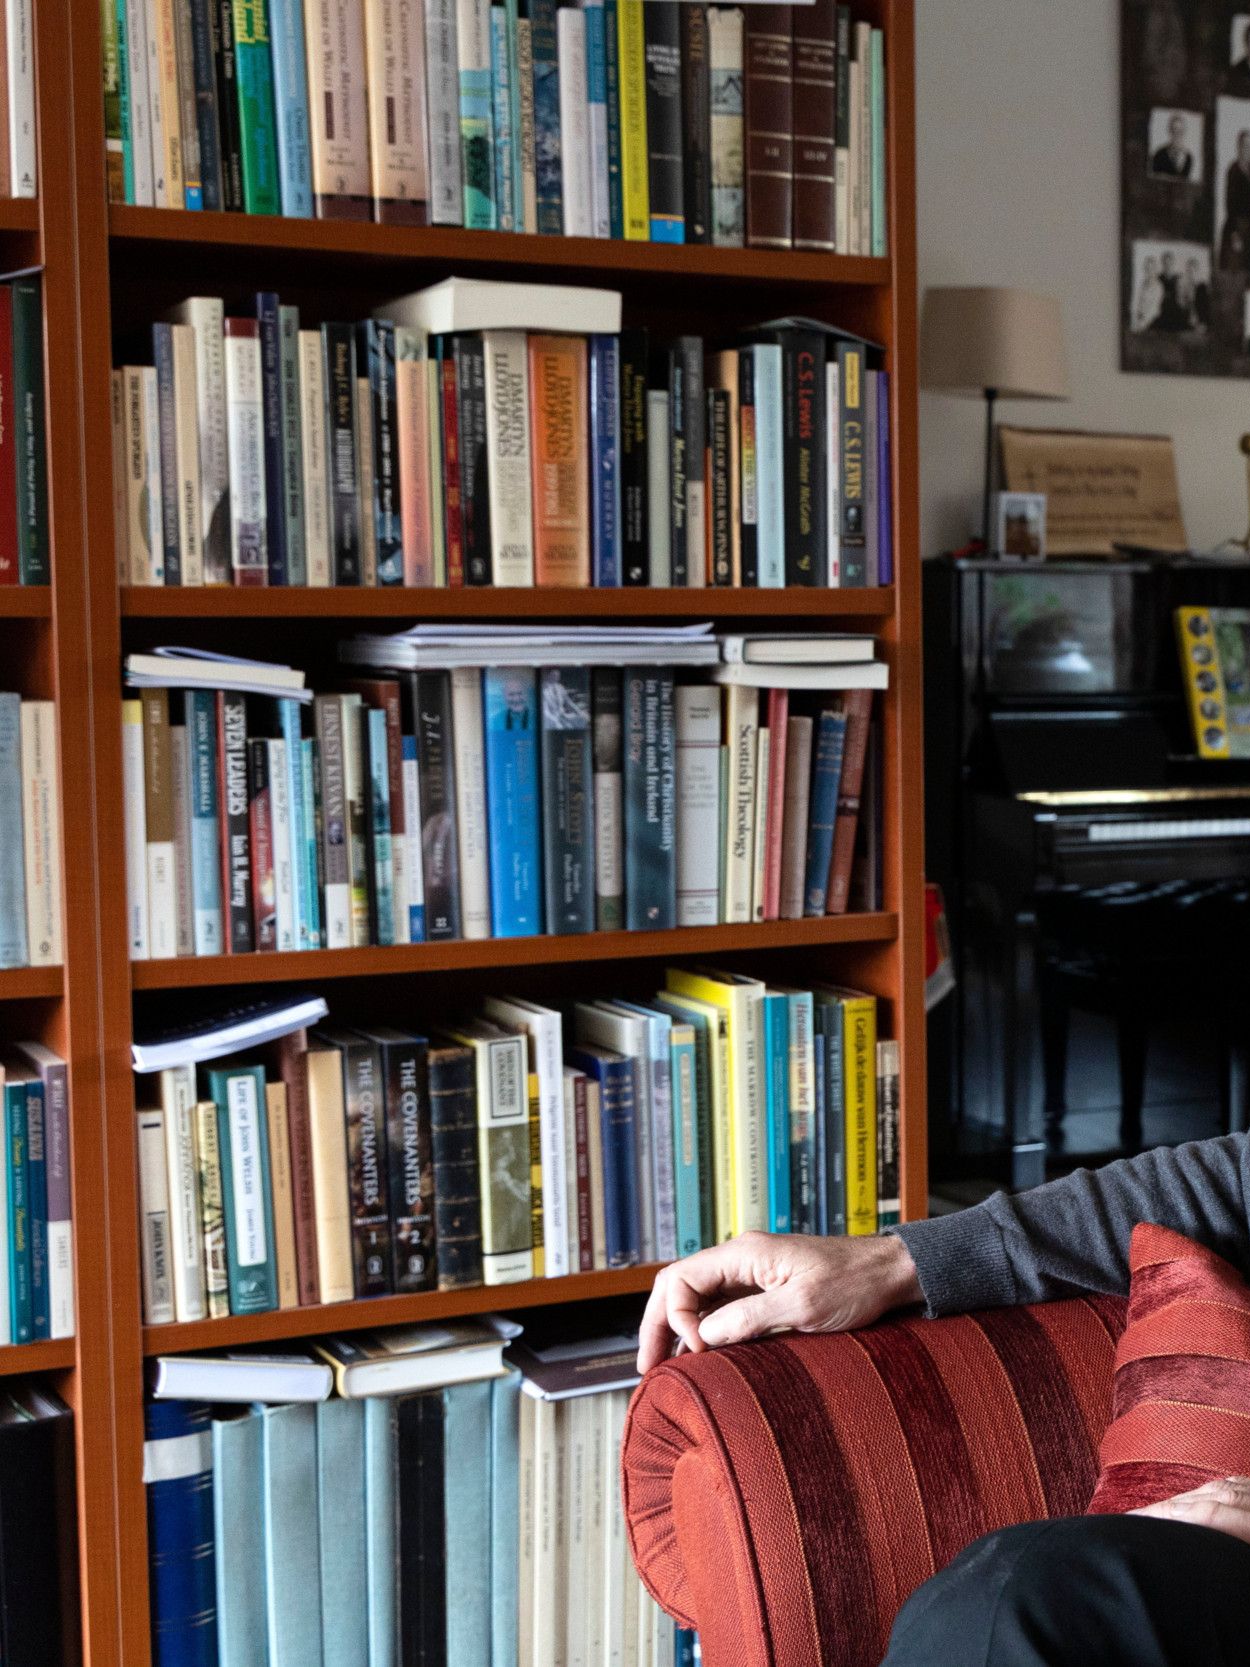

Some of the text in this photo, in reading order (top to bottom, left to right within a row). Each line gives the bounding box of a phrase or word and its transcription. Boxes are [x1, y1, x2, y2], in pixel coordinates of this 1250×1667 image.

[225, 52, 233, 78] Evans
[461, 354, 471, 389] Murray
[24, 392, 34, 417] Liberty
[799, 389, 815, 439] Lewis
[25, 418, 33, 433] and
[336, 428, 354, 494] AUTOBIOGRAPHY
[674, 439, 685, 471] Martyn
[845, 453, 861, 499] LEWIS
[27, 492, 36, 515] Pursuit
[28, 517, 36, 525] In
[800, 486, 811, 535] McGrath
[224, 705, 247, 816] SEVEN LEADERS
[324, 704, 343, 816] ERNEST KEVAN
[646, 679, 659, 822] in Britain and Ireland
[659, 682, 674, 851] The History of Christianity
[734, 724, 753, 859] Scottish Theology
[232, 835, 248, 907] Iain Murray
[797, 1062, 807, 1084] van
[237, 1081, 248, 1105] LIFE
[798, 1087, 809, 1106] het
[854, 1018, 867, 1182] Gelijk de dauw van Hermon
[240, 1125, 251, 1152] JOHN
[359, 1059, 378, 1205] THE COVENANTERS
[400, 1060, 421, 1205] THE COVENANTERS
[243, 1157, 253, 1194] WELSH
[153, 1221, 163, 1249] JOHN
[369, 1232, 377, 1244] 1
[410, 1230, 421, 1244] 2
